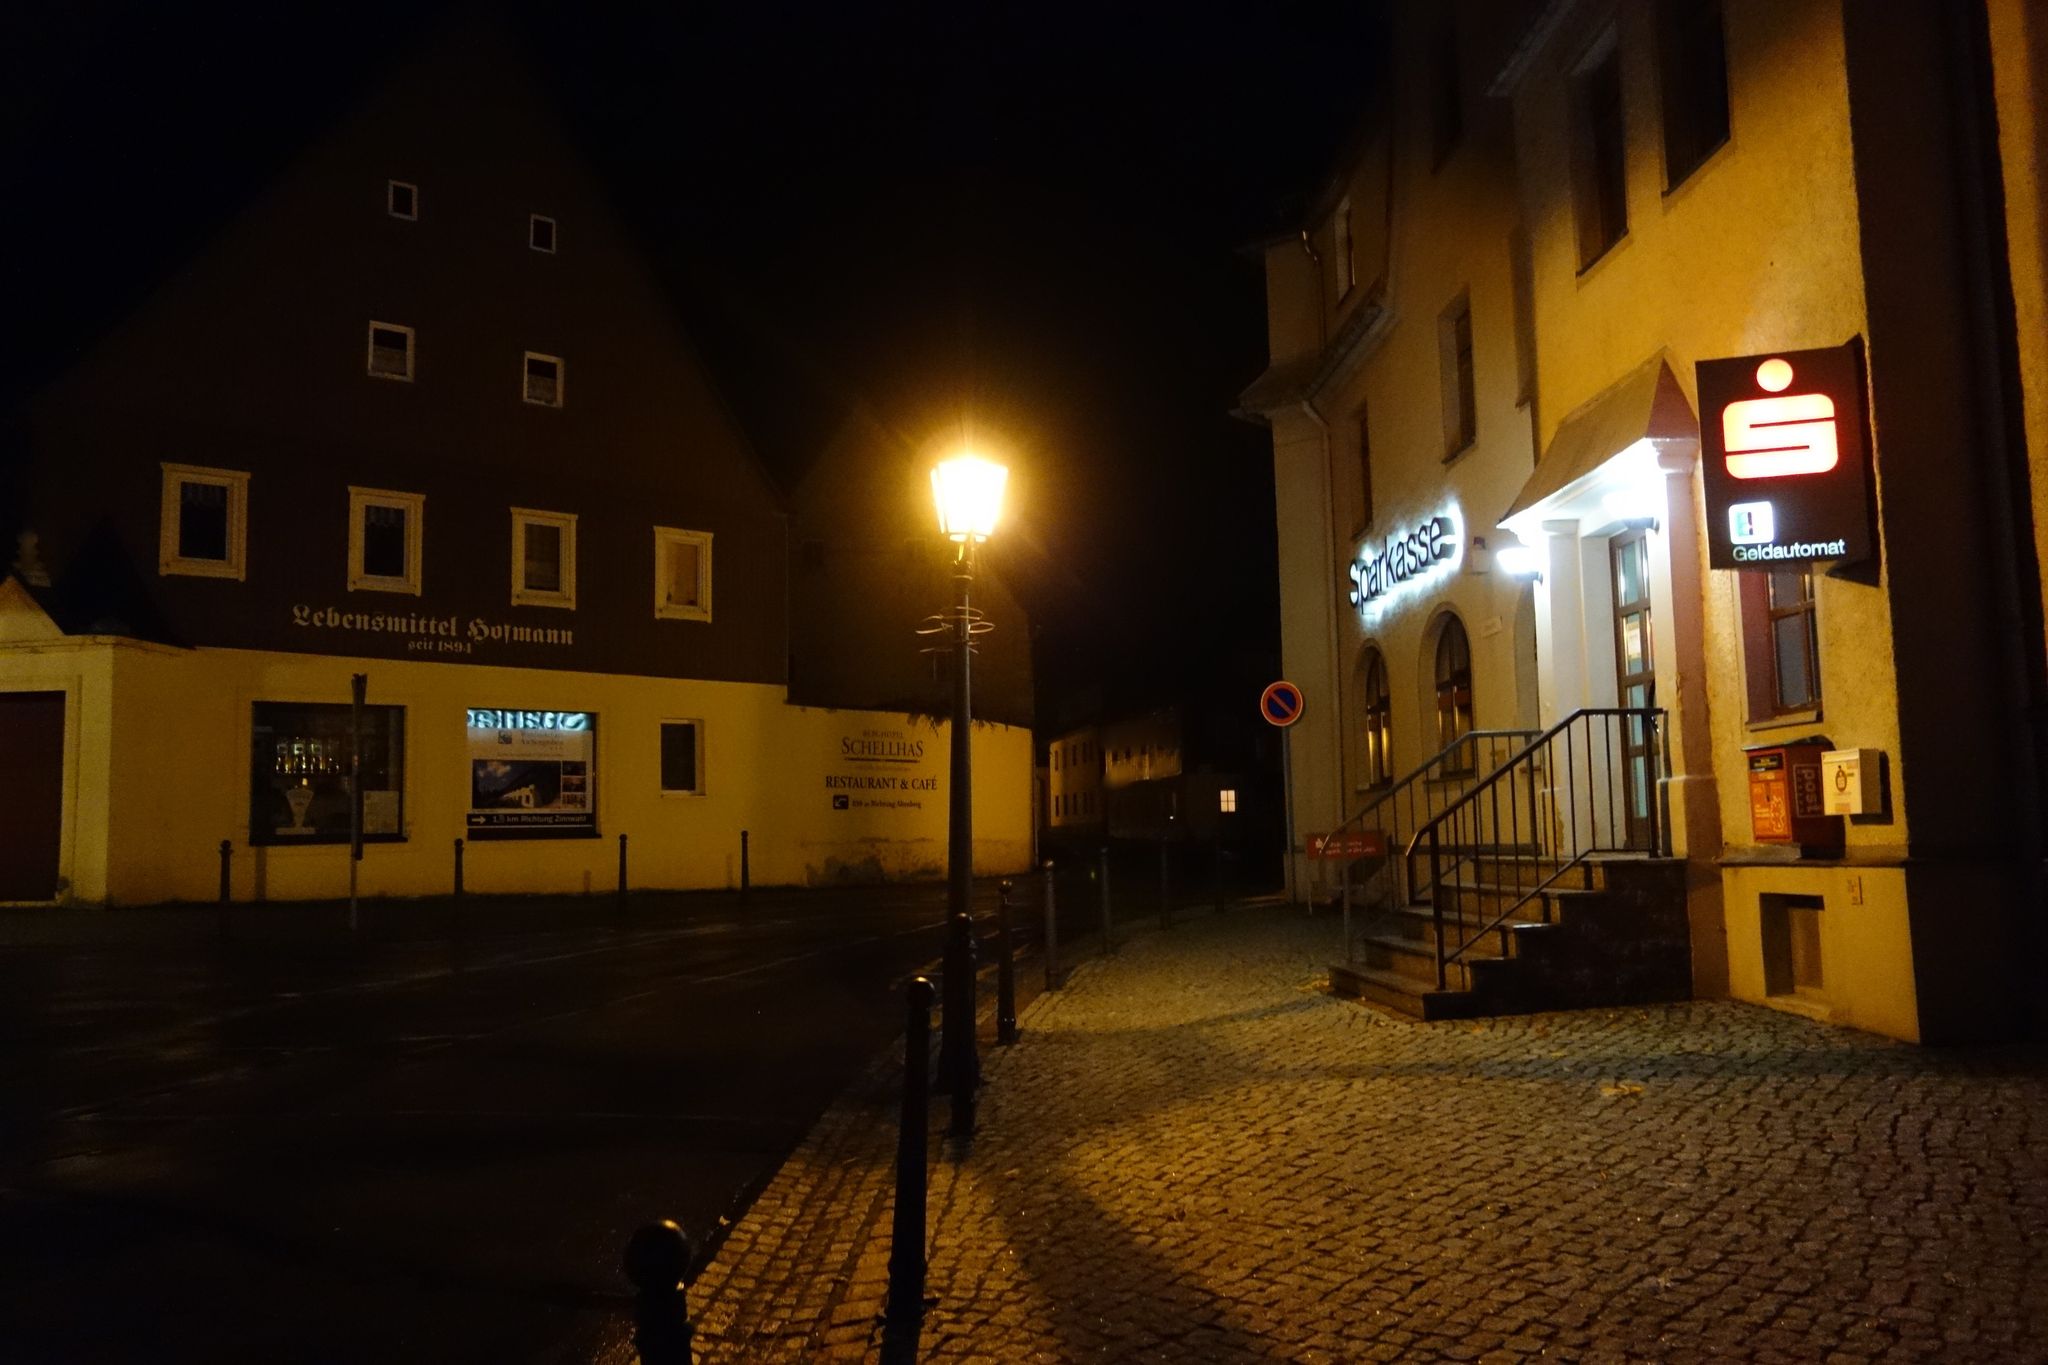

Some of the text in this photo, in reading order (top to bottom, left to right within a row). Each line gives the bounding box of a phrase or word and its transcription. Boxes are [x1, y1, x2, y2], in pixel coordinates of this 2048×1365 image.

[1732, 539, 1846, 561] Geldautomat
[1349, 517, 1447, 614] Sparkasse
[291, 604, 574, 645] Lebensmittel Hofmann
[407, 638, 472, 654] seit 1894
[841, 737, 924, 757] SCHELLHAS
[826, 775, 938, 790] RESTAURANT & CAFÉ
